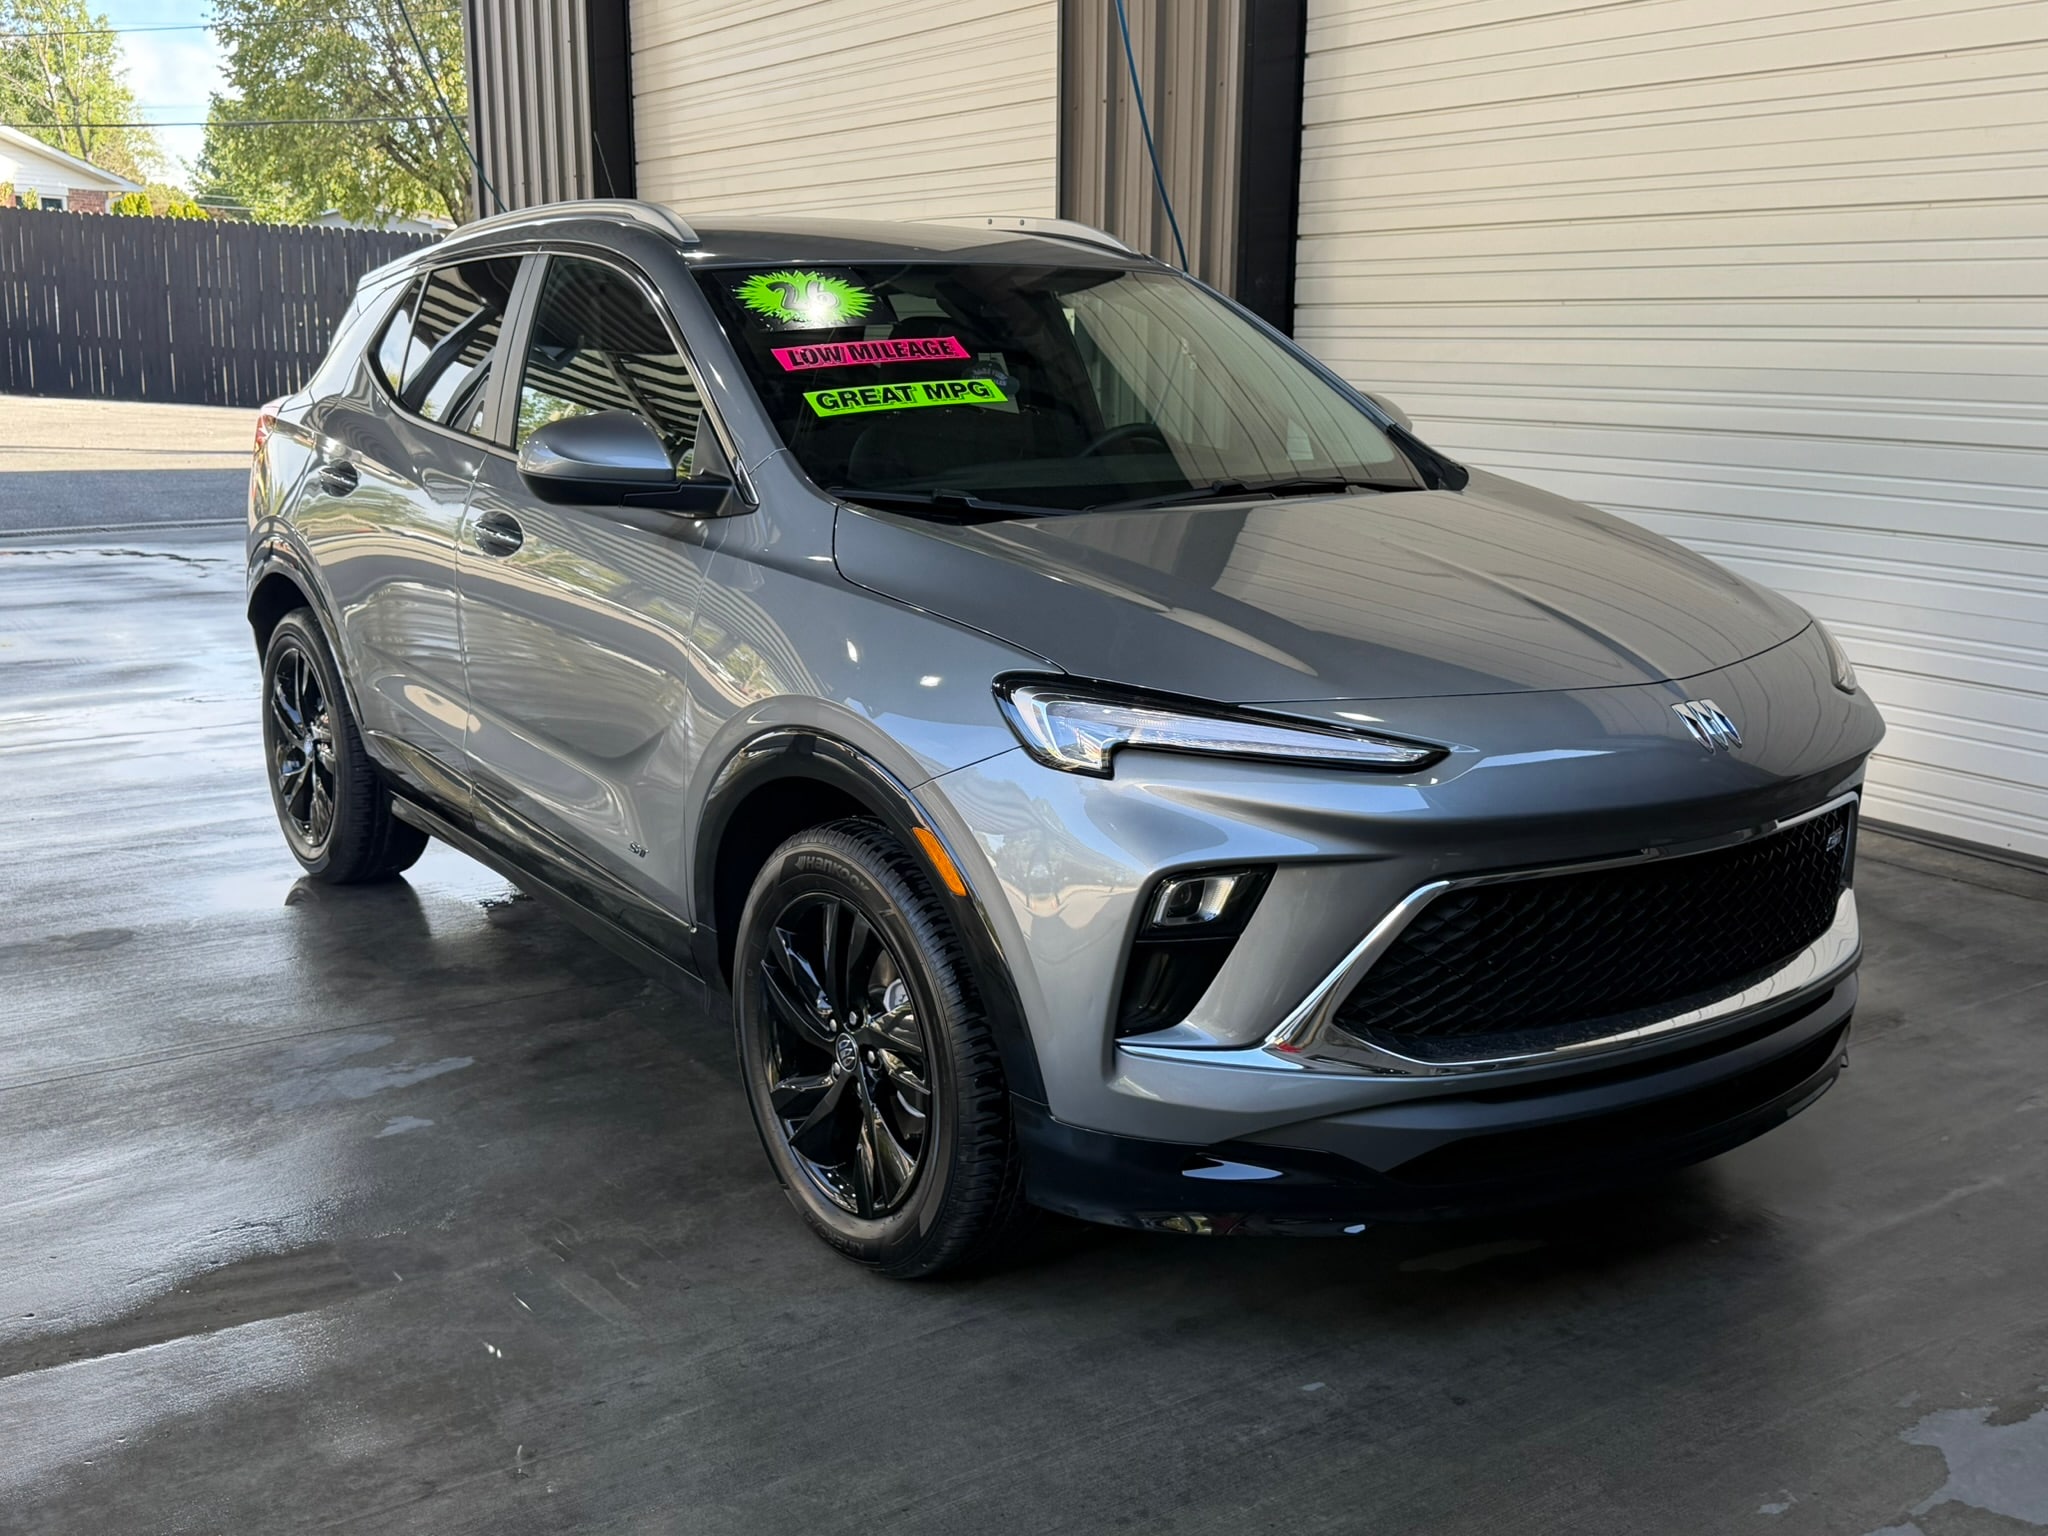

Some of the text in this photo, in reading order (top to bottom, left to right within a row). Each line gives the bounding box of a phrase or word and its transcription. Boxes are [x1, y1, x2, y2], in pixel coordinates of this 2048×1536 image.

[765, 279, 839, 312] 26
[786, 340, 956, 367] LOW MILEAGE
[816, 381, 995, 411] GREAT MPG
